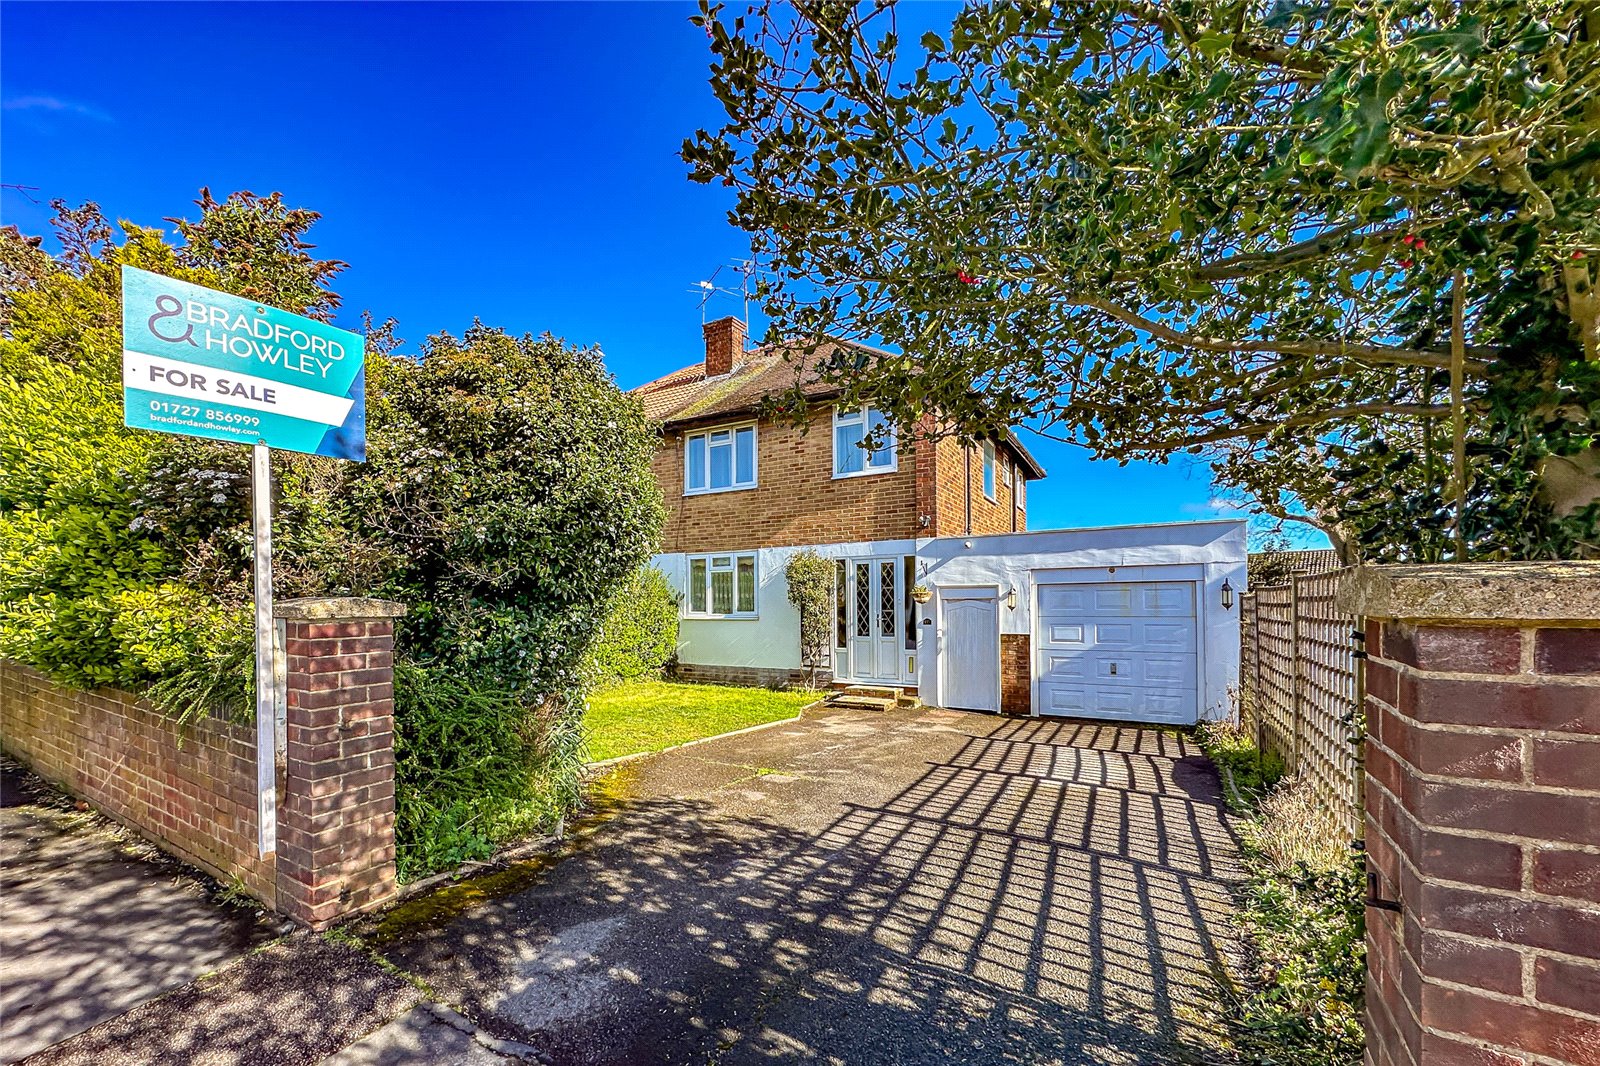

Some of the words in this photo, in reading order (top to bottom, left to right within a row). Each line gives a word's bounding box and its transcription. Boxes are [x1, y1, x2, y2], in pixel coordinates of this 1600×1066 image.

[148, 295, 199, 347] &
[186, 301, 345, 361] BRADFORD
[206, 330, 333, 378] HOWLEY
[150, 365, 207, 391] FOR
[216, 379, 276, 404] SALE
[150, 401, 200, 418] 01727
[206, 410, 260, 427] 856999
[150, 414, 260, 436] bradfordandhowley.com
